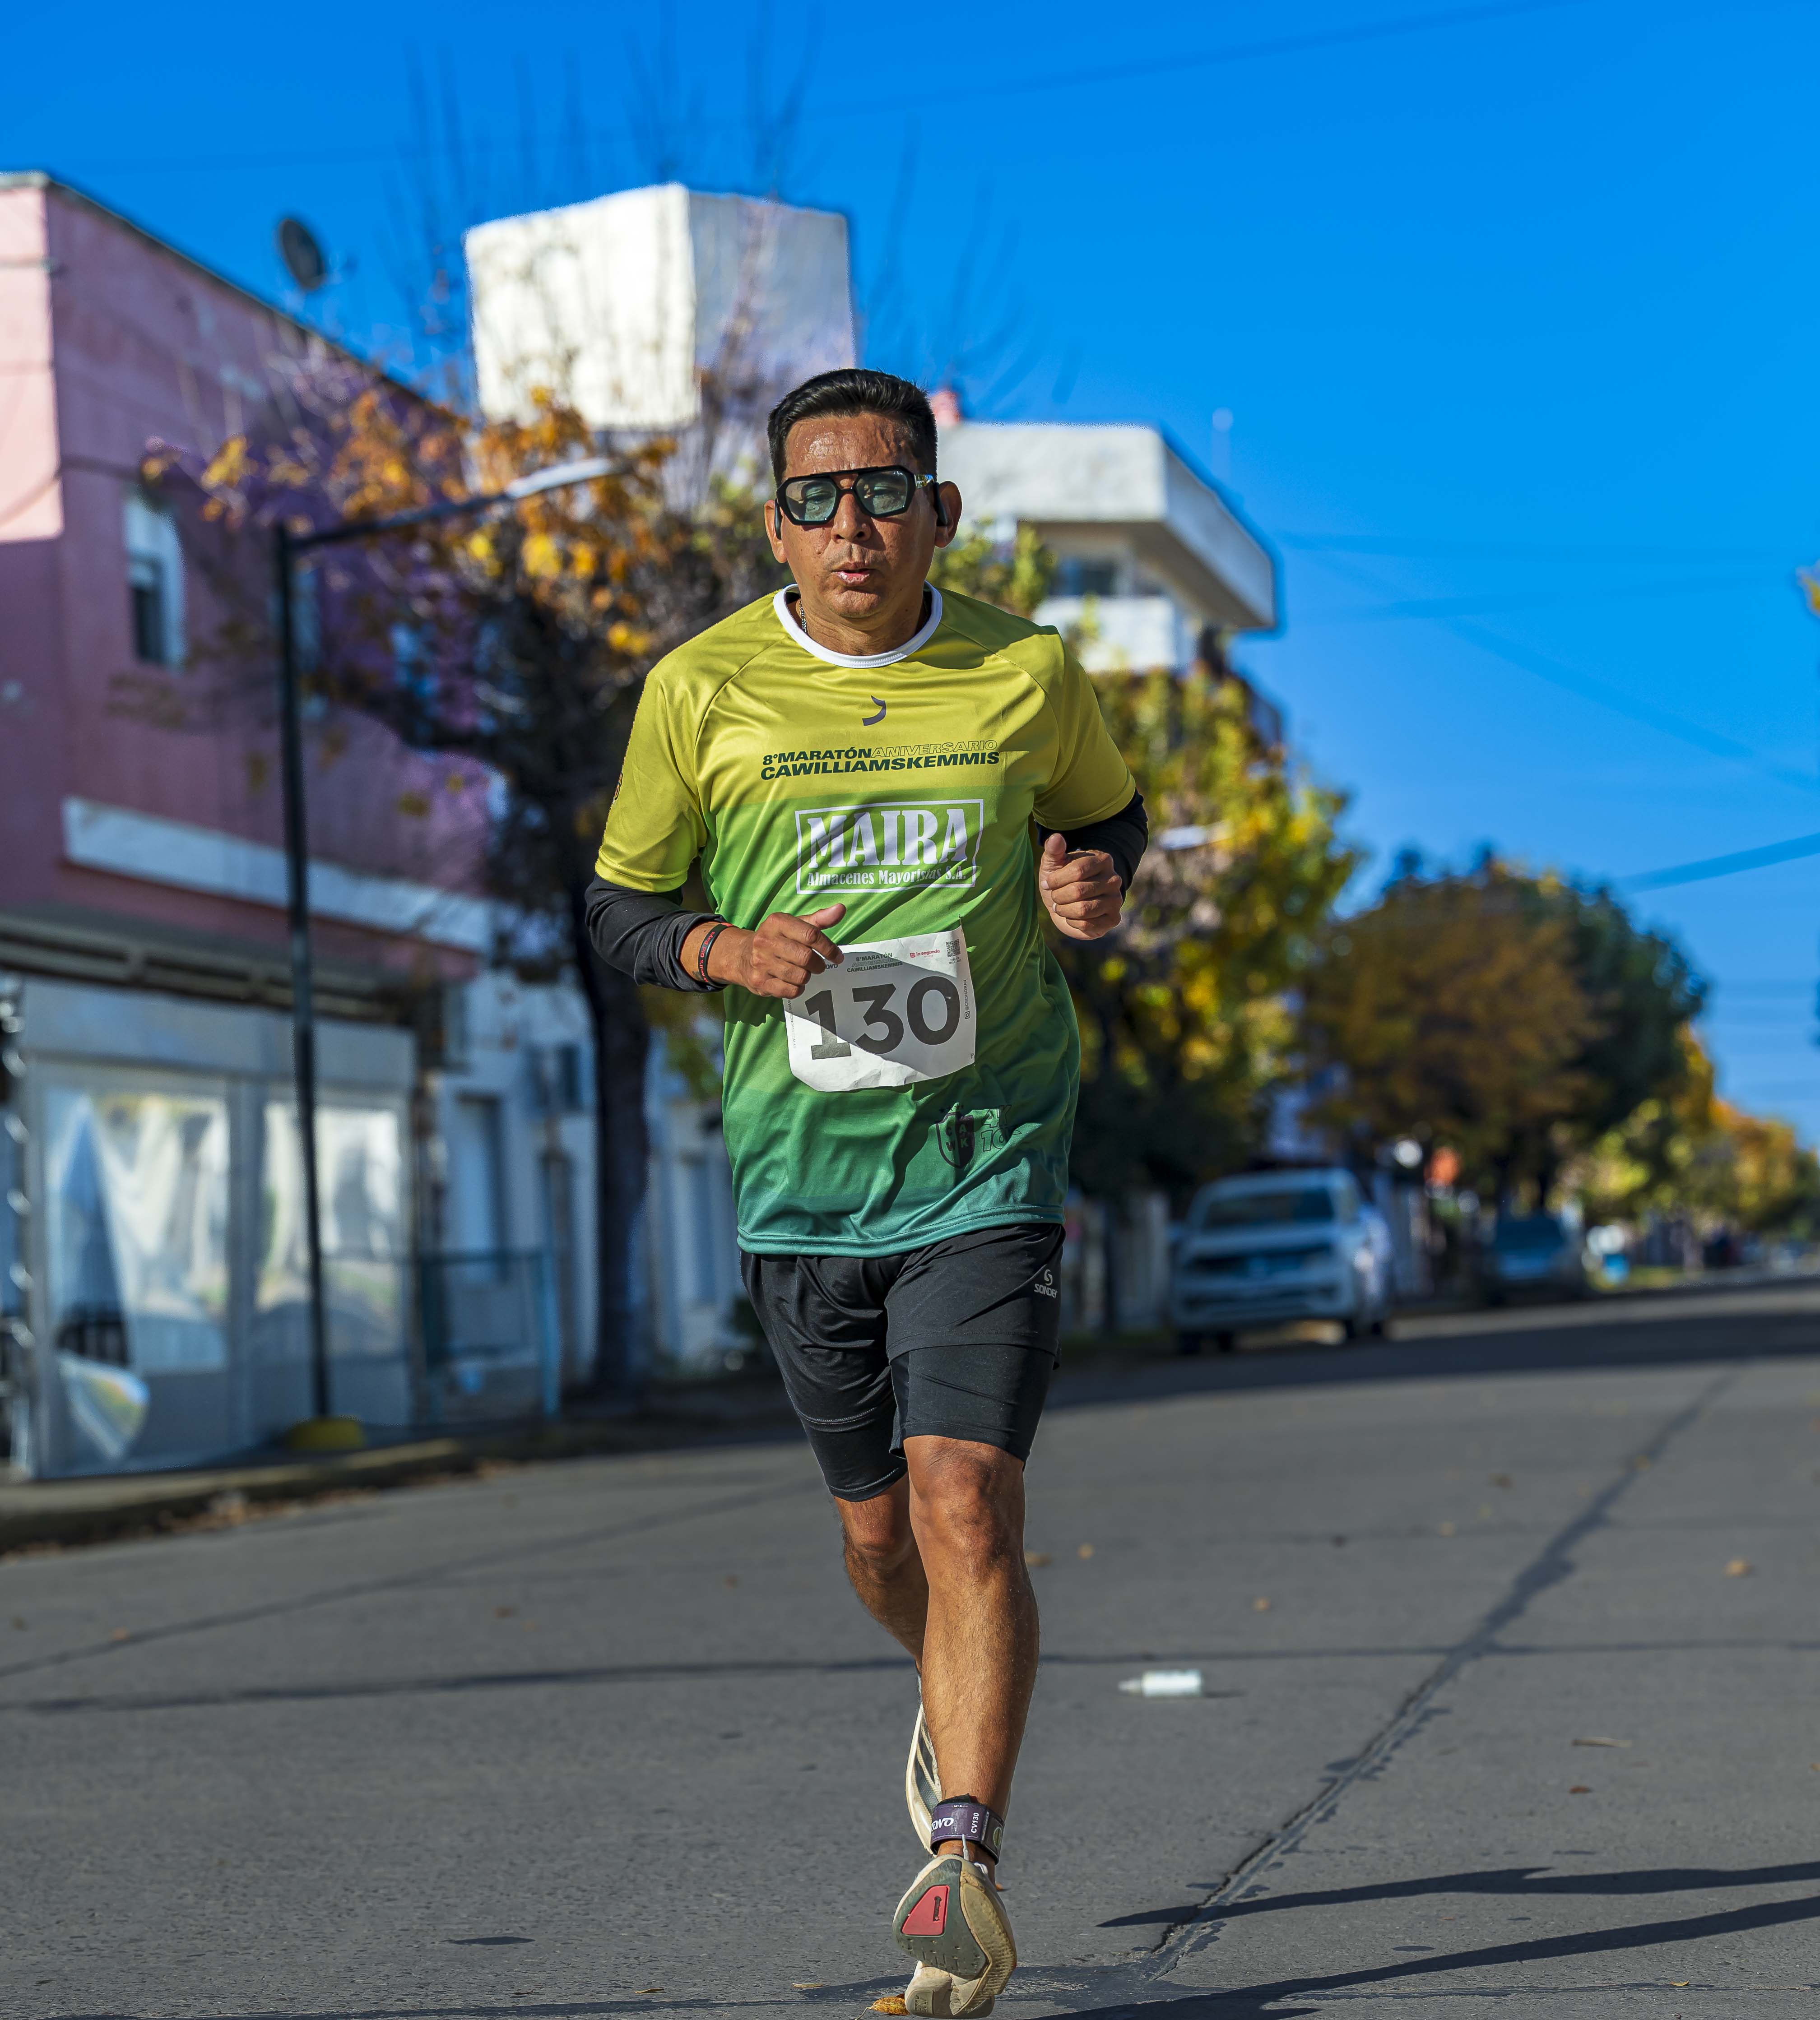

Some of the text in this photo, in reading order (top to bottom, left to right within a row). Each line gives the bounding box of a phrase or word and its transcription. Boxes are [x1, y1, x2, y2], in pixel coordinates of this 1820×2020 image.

[761, 751, 1000, 780] CAWILLIAMSKEMMIS
[807, 808, 968, 868] MAIRA
[807, 866, 966, 886] Almacenes Mayoristas S.A.
[847, 962, 903, 972] CAWILLIAMSKEMMIS
[804, 976, 961, 1060] 130
[971, 1812, 979, 1833] CV130
